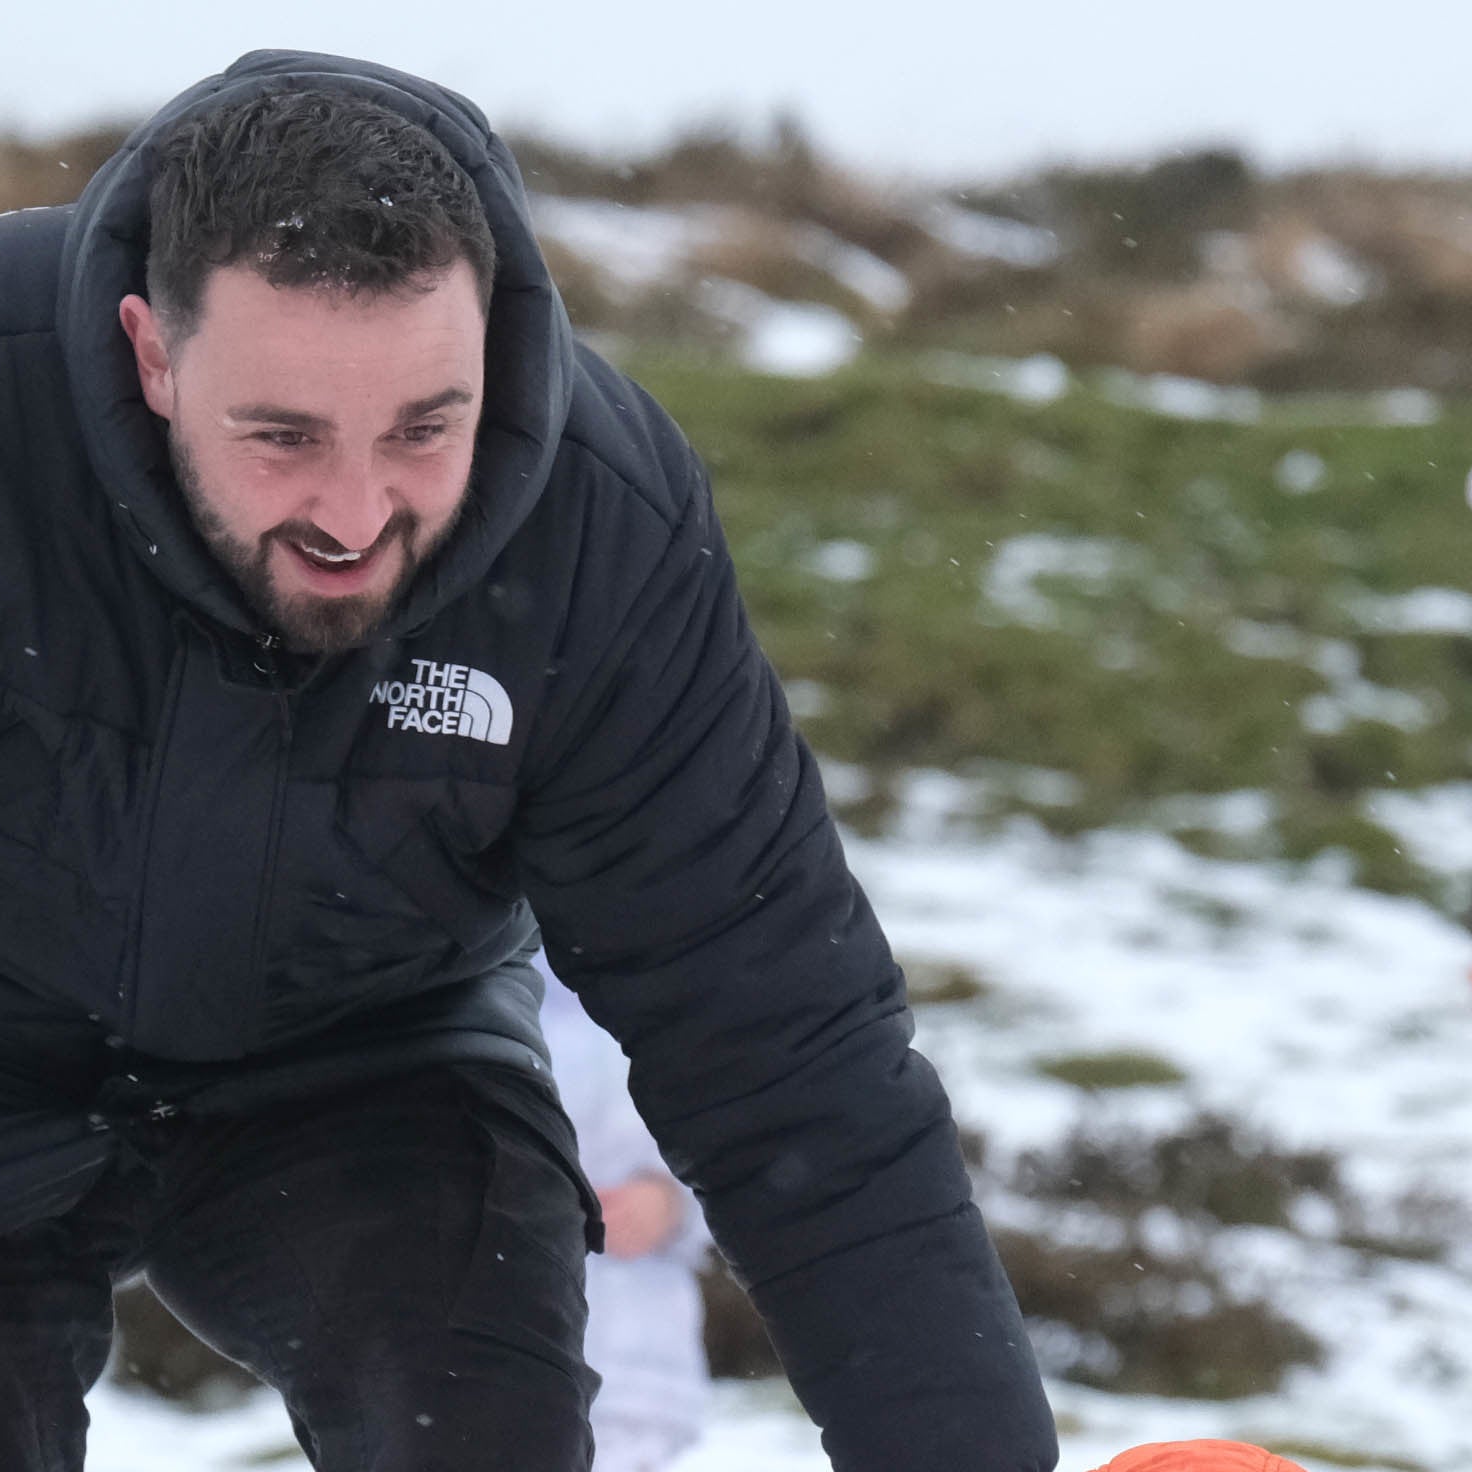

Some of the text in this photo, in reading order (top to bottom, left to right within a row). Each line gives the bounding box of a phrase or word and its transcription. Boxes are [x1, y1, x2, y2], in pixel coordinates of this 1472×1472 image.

[411, 659, 469, 689] THE
[369, 680, 464, 711] NORTH
[388, 705, 460, 734] FACE
